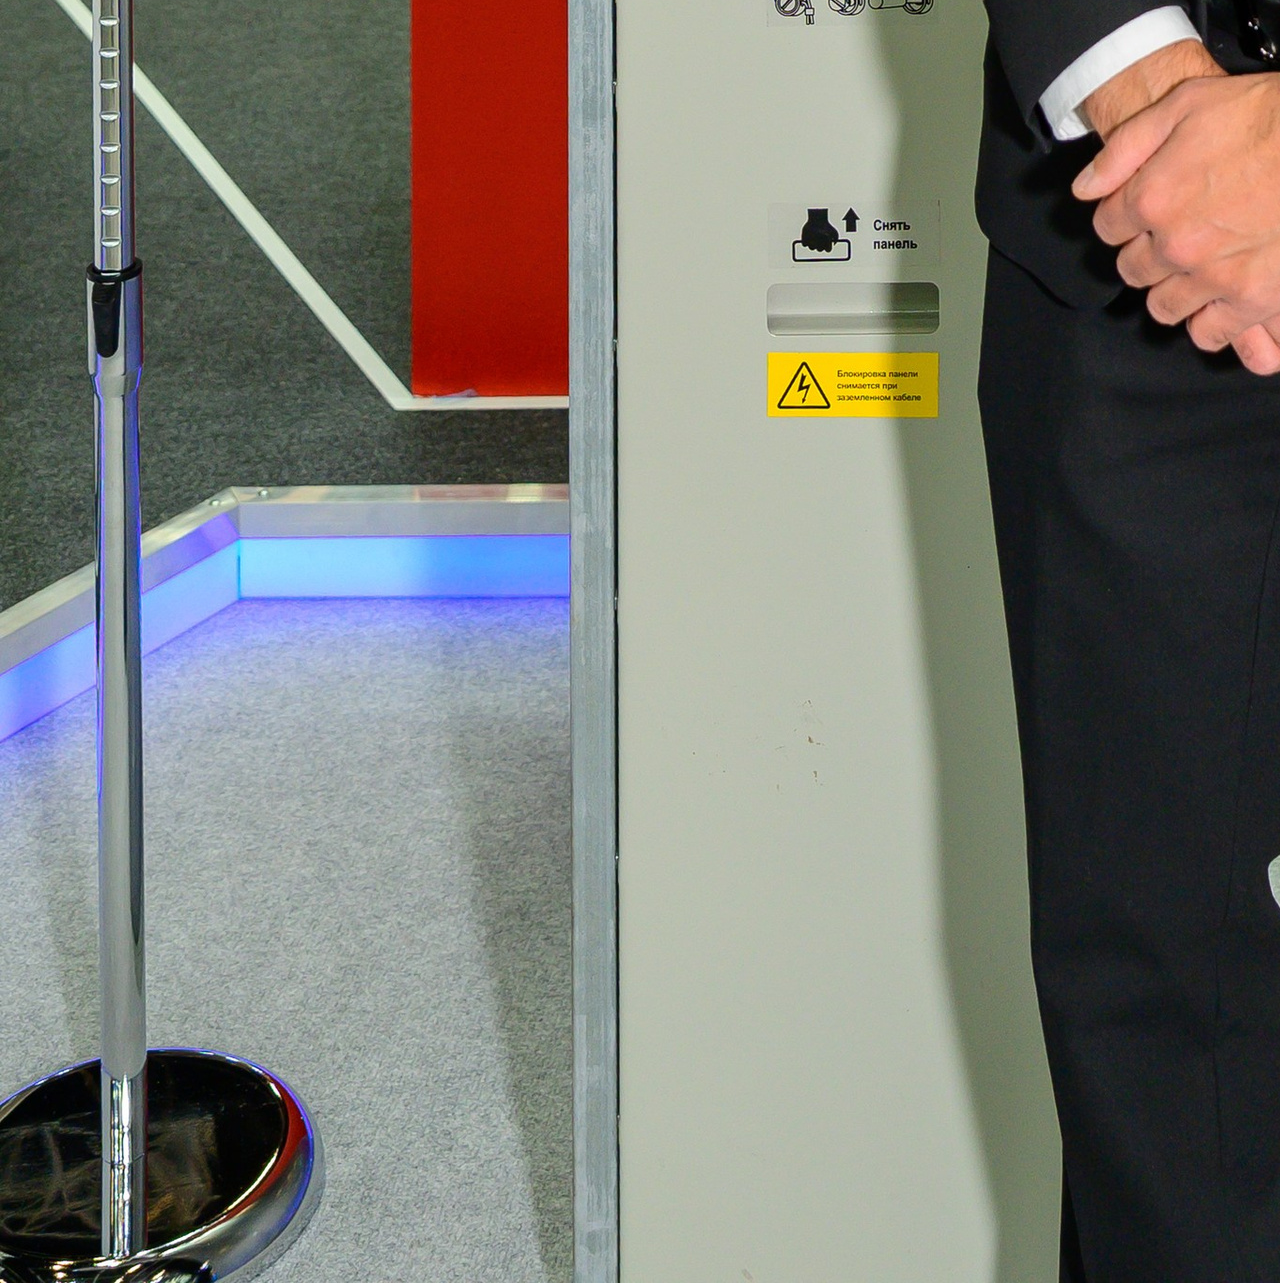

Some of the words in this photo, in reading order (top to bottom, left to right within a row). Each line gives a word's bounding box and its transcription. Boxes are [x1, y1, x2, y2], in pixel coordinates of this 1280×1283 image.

[873, 219, 911, 231] Снять
[873, 239, 918, 249] панель
[837, 369, 887, 379] Блокировка
[892, 393, 922, 401] кабеле
